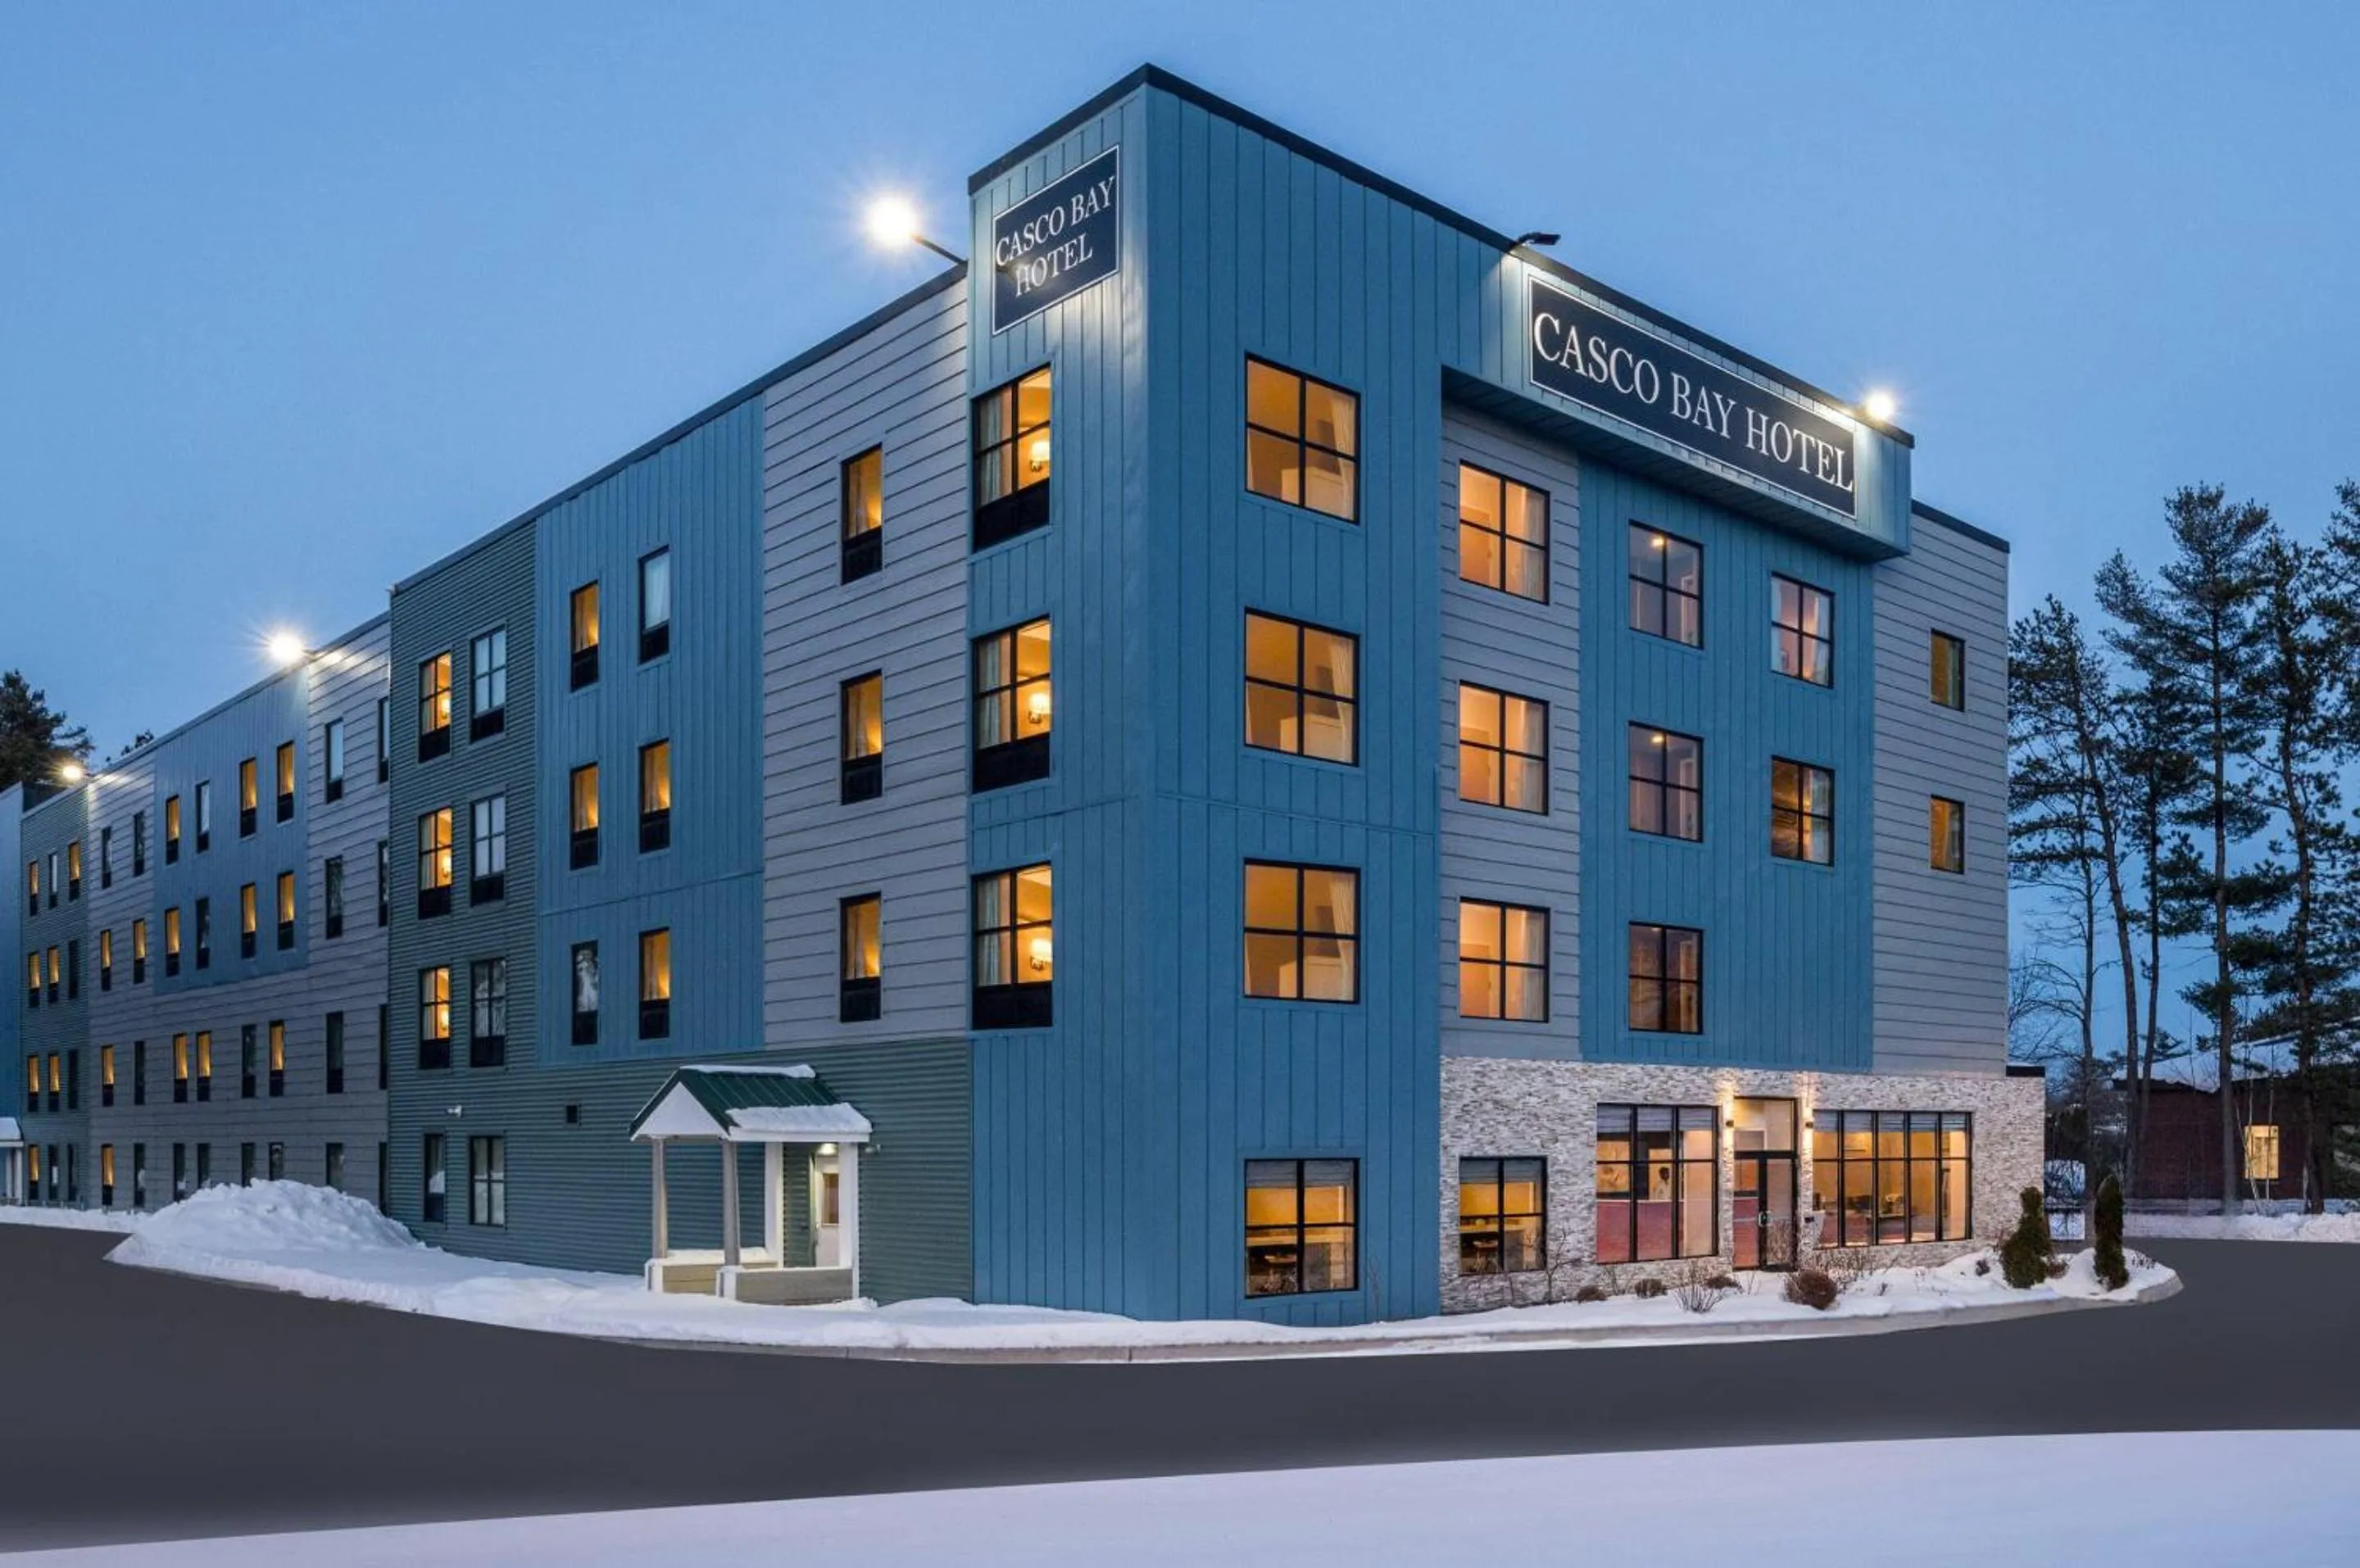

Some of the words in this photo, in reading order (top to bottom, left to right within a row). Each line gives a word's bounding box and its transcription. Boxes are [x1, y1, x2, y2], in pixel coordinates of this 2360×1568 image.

[996, 206, 1064, 267] CASCO
[1071, 175, 1115, 226] BAY
[1015, 233, 1093, 297] HOTEL
[1534, 312, 1659, 405] CASCO
[1671, 372, 1737, 440] BAY
[1745, 407, 1854, 492] HOTEL
